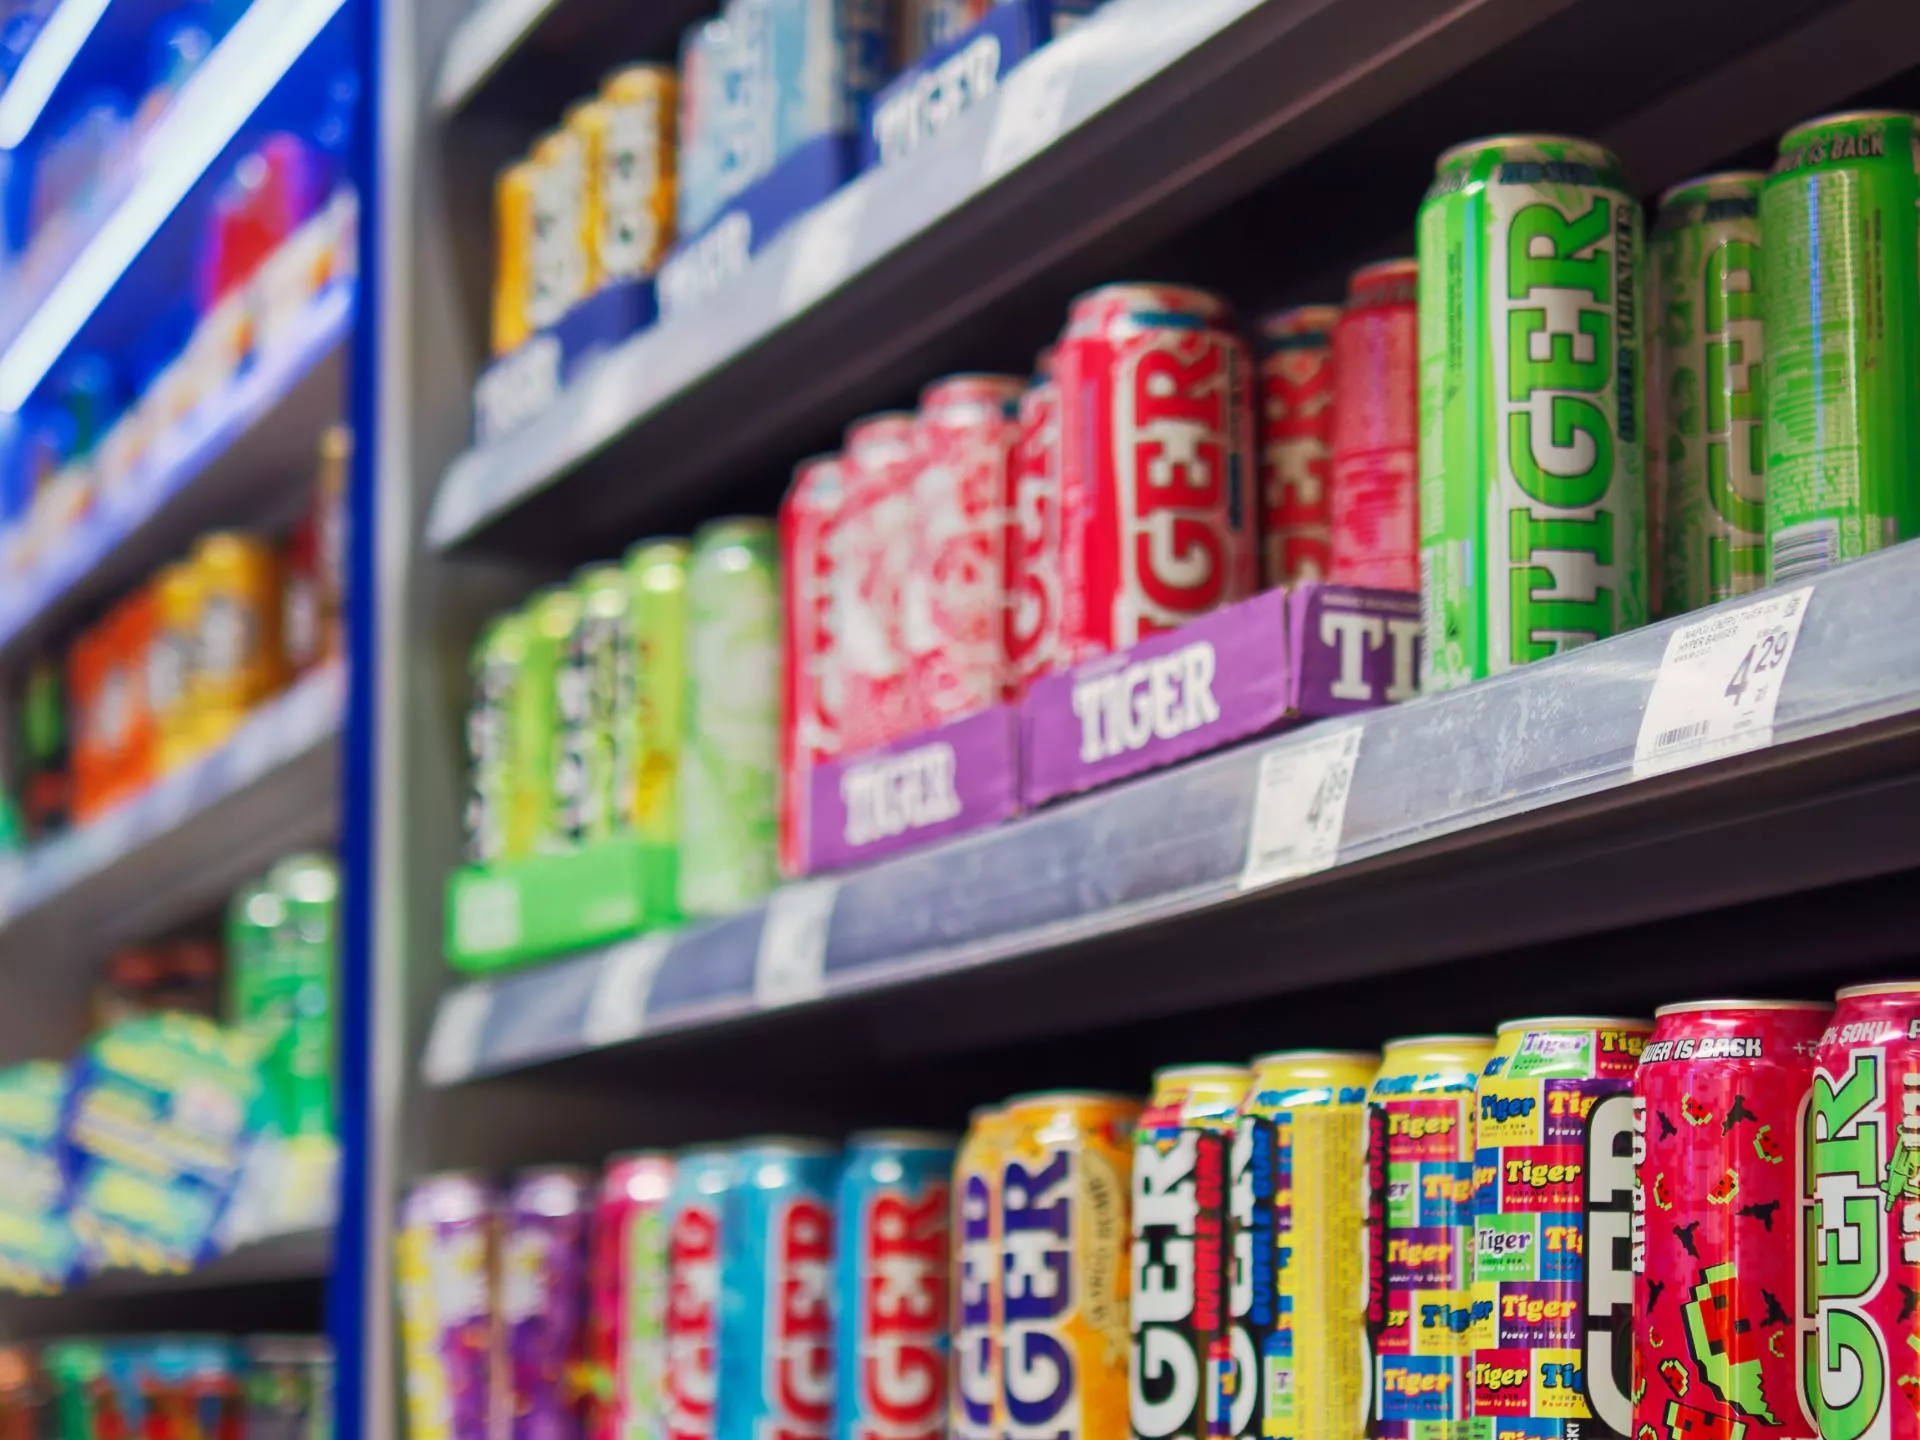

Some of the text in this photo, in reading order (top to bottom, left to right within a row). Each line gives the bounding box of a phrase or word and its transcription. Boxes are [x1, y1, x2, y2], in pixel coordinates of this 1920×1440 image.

[1830, 133, 1884, 160] BACK
[1507, 195, 1613, 663] TIGER
[1724, 631, 1788, 706] 4 29
[1072, 641, 1220, 763] TIGER
[841, 741, 962, 846] TIGER
[1524, 1031, 1588, 1056] Tiger
[1673, 1039, 1696, 1060] IS
[1697, 1036, 1763, 1059] BACK
[1481, 1094, 1536, 1123] Tiger
[1506, 1160, 1582, 1188] Tiger
[1368, 1115, 1384, 1323] BUBBLE GUM
[1478, 1229, 1532, 1255] Tiger
[1501, 1294, 1578, 1325] Tiger
[1501, 1331, 1529, 1340] Power
[1383, 1367, 1452, 1398] Tiger
[1475, 1362, 1529, 1391] Tiger
